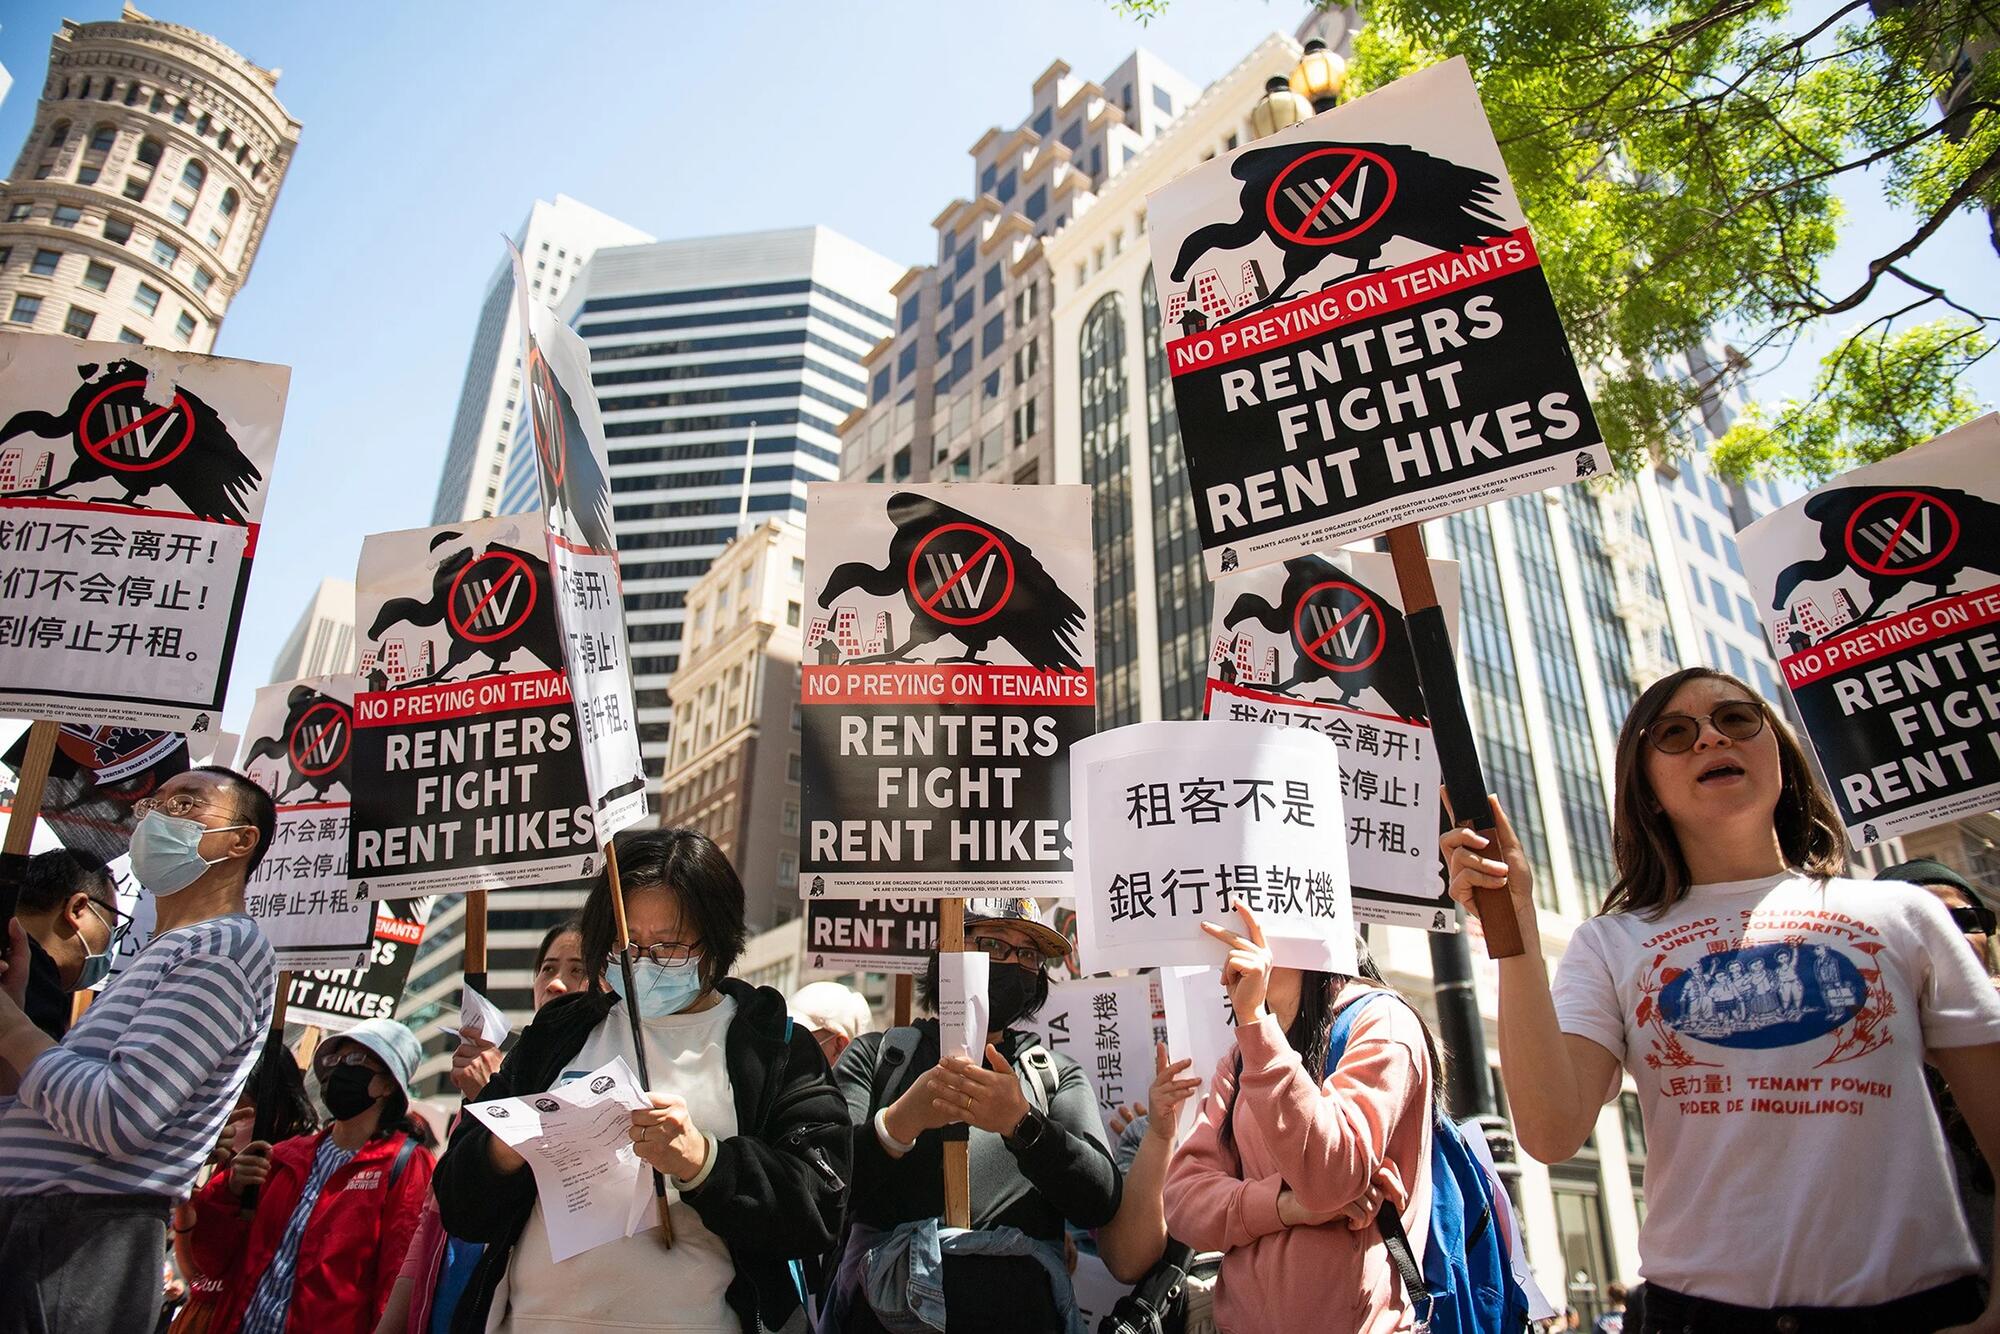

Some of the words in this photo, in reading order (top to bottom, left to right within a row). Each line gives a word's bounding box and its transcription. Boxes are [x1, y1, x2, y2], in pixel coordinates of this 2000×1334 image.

[1176, 338, 1215, 368] NO
[1222, 298, 1339, 355] PREYING
[1347, 283, 1388, 313] ON
[1396, 239, 1526, 300] TENANTS
[1220, 295, 1504, 412] RENTERS
[1277, 361, 1463, 451] FIGHT
[1205, 447, 1361, 534] RENT
[1382, 392, 1580, 485] HIKES
[1249, 541, 1276, 552] TENANTS
[1277, 534, 1300, 545] ACROSS
[1310, 528, 1322, 536] ARE
[1323, 517, 1362, 532] ORGANIZING
[1363, 509, 1389, 521] AGAINST
[1390, 500, 1426, 513] PREDATORY
[1427, 489, 1465, 503] LANDLORDS
[1466, 485, 1481, 493] LIKE
[1482, 478, 1508, 489] VERITAS
[1324, 527, 1357, 540] STRONGER
[1451, 496, 1467, 504] VISIT
[0, 519, 217, 564] 们不会离开!
[0, 567, 207, 610] 们不会停止!
[1788, 654, 1822, 681] NO
[1824, 615, 1929, 666] PREYING
[1931, 605, 1969, 630] ON
[359, 698, 389, 721] NO
[393, 686, 475, 717] PREYING
[480, 683, 508, 706] ON
[808, 673, 841, 696] NO
[846, 673, 945, 696] PREYING
[950, 673, 982, 696] ON
[987, 674, 1088, 697] TENANTS
[386, 714, 572, 772] RENTERS
[839, 715, 1058, 757] RENTERS
[416, 764, 538, 815] FIGHT
[877, 767, 1021, 809] FIGHT
[1840, 739, 1975, 814] RENT
[1126, 777, 1315, 828] 租客不是
[357, 821, 461, 869] RENT
[475, 806, 594, 858] HIKES
[811, 820, 932, 862] RENT
[245, 889, 360, 918] 到停止升租。
[1108, 864, 1337, 922] 銀行提款機
[814, 916, 895, 948] RENT
[1642, 917, 1717, 949] UNIDAD
[1740, 910, 1880, 937] SOLIDARIDAD
[1661, 927, 1719, 951] UNITY
[1741, 921, 1861, 941] SOLIDARITY
[316, 984, 395, 1020] HIKES
[1727, 1099, 1744, 1113] DE
[1747, 1077, 1823, 1092] TENANT
